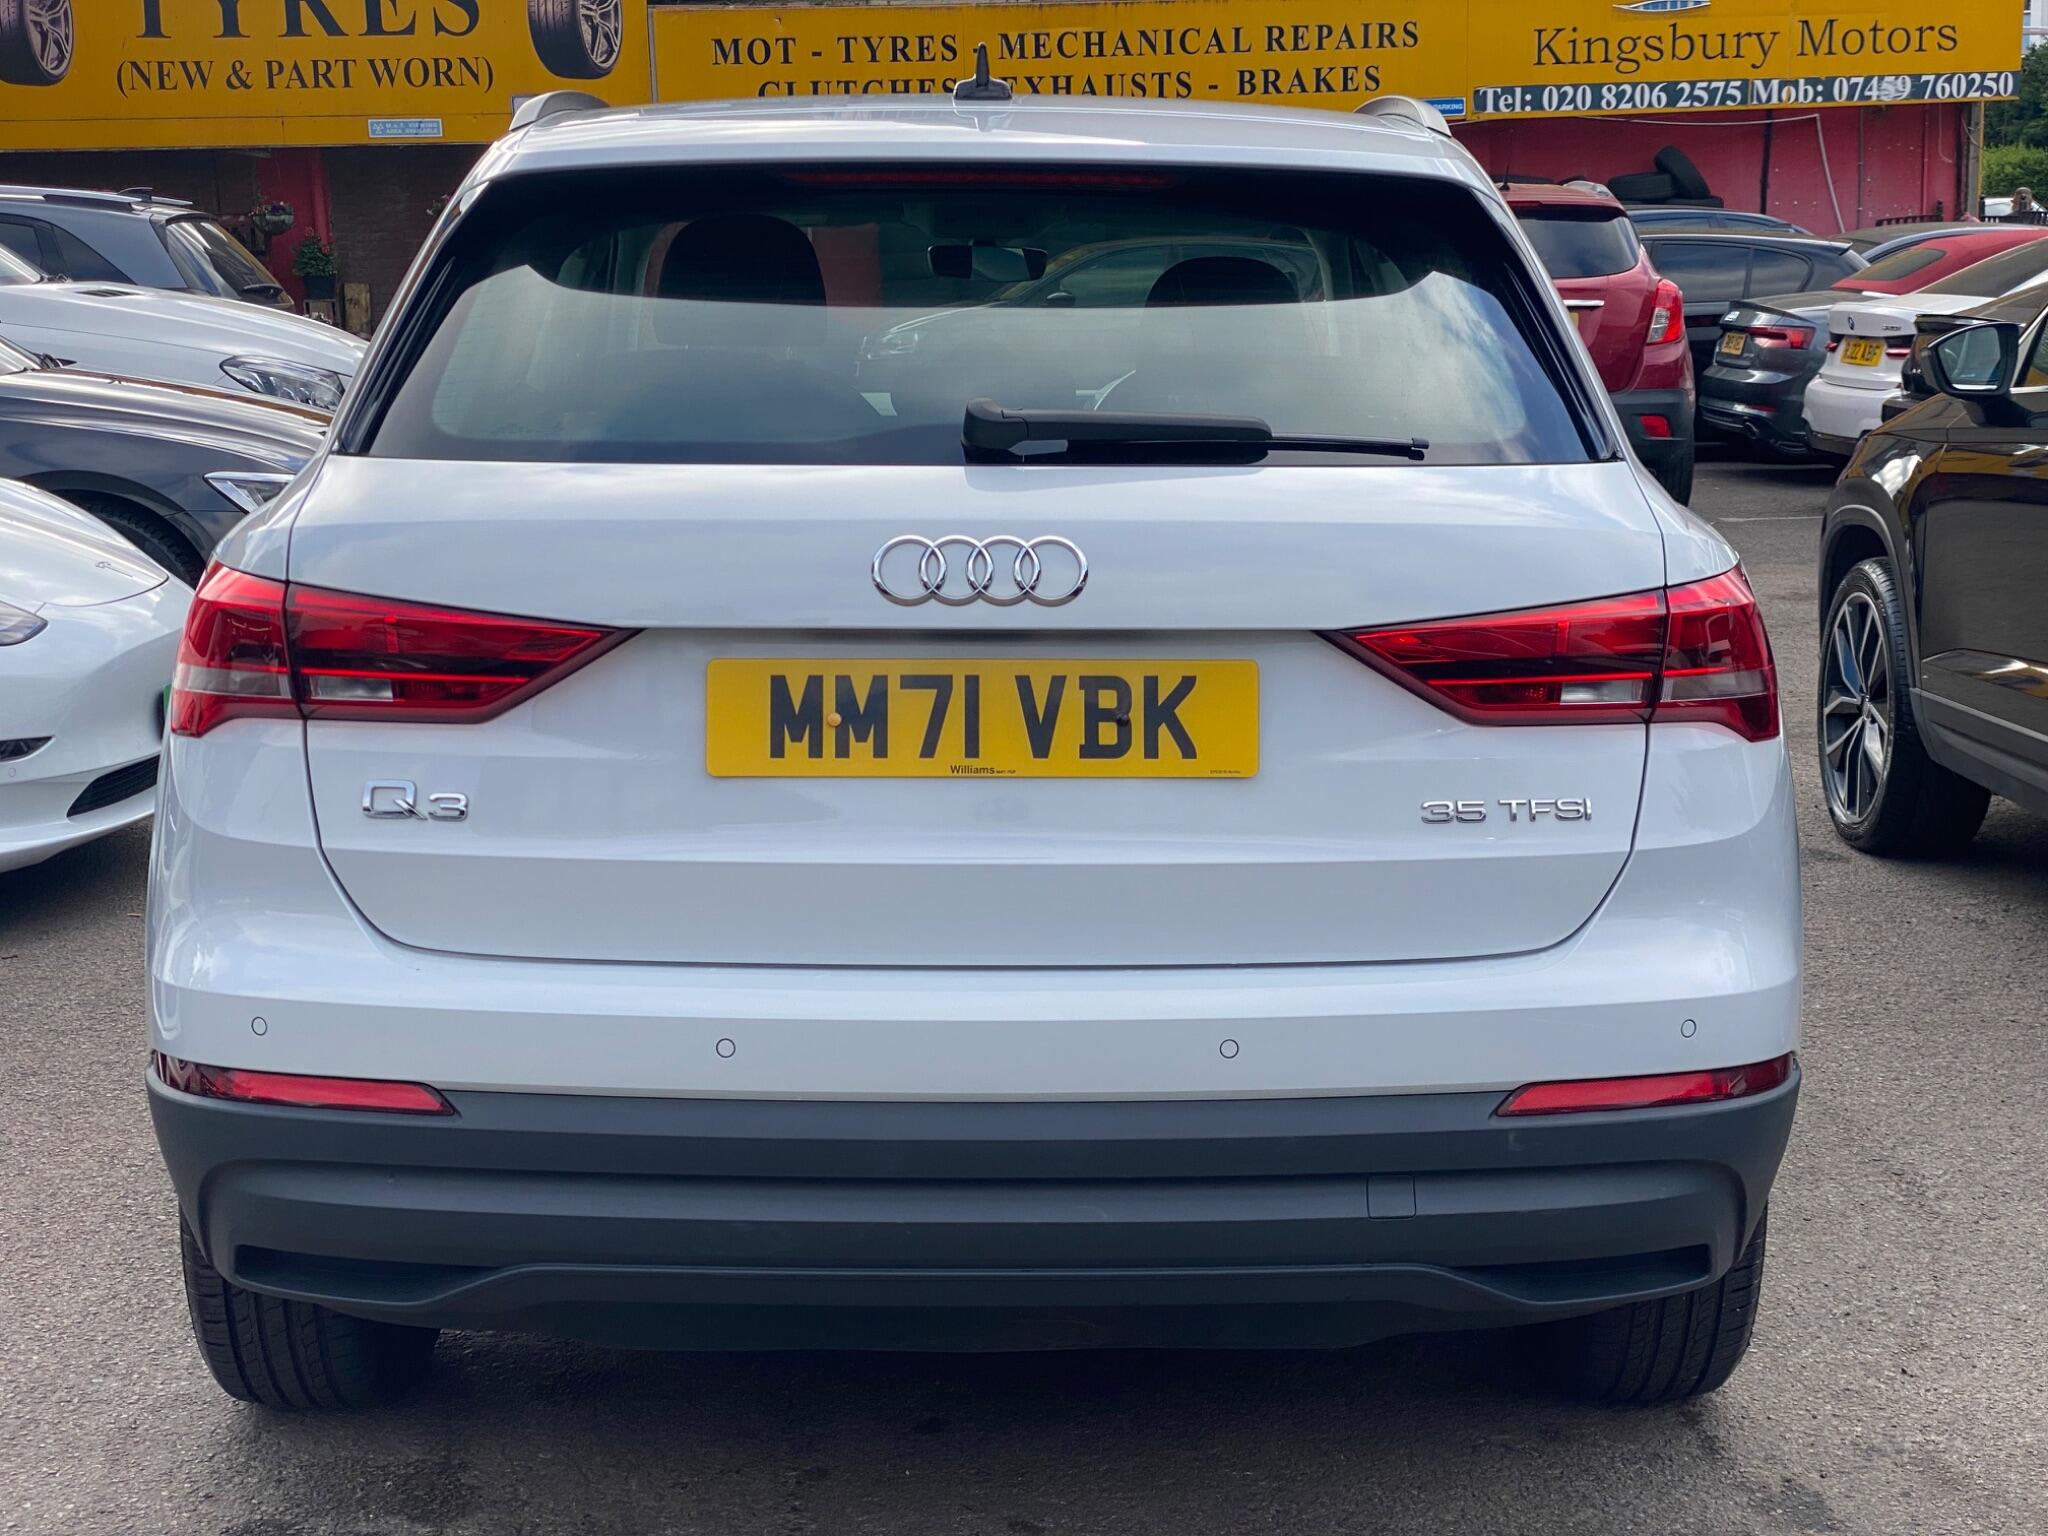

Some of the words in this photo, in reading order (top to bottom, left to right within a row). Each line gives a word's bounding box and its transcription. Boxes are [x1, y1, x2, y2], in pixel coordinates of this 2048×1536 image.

[712, 37, 796, 66] MOT
[837, 33, 958, 63] TYRES
[998, 26, 1252, 60] MECHANICAL
[1265, 20, 1419, 52] REPAIRS
[1533, 22, 1780, 75] Kingsbury
[1797, 18, 1959, 57] Motors
[116, 59, 213, 98] (NEW
[225, 60, 254, 91] &
[264, 58, 357, 89] PART
[367, 55, 494, 93] WORN)
[1236, 65, 1381, 96] BRAKES
[1479, 87, 1532, 113] Tel:
[1542, 85, 1592, 112] 020
[1600, 82, 1668, 110] 8206
[1675, 80, 1742, 107] 2575
[1751, 78, 1824, 105] Mob:
[1920, 71, 2014, 99] 760250
[770, 674, 980, 759] MM71
[1015, 675, 1198, 759] VBK
[950, 764, 995, 774] Williams
[361, 779, 469, 822] Q3
[1421, 799, 1486, 824] 35
[1498, 798, 1592, 822] TFSI
